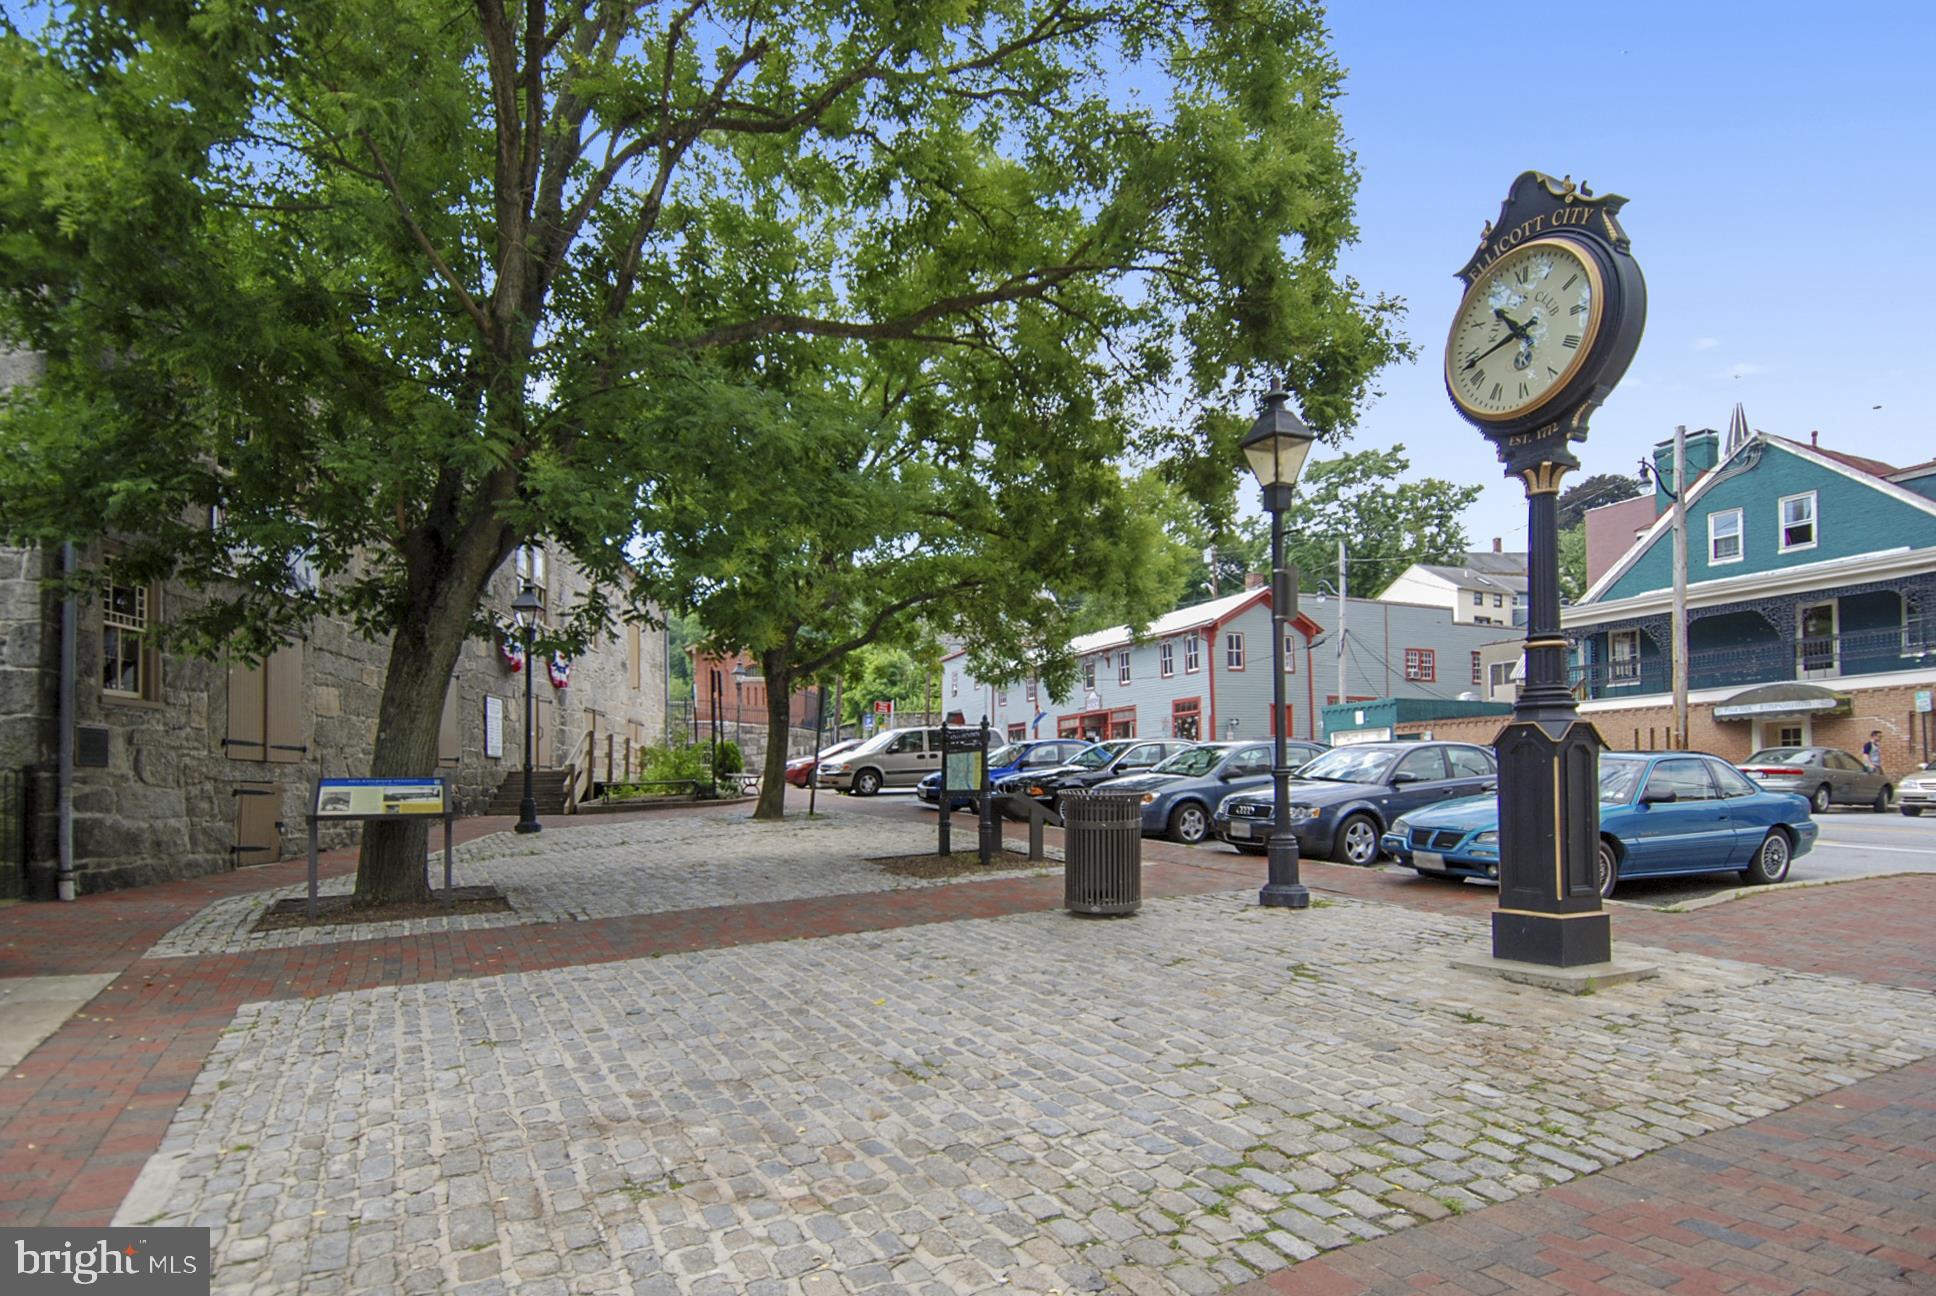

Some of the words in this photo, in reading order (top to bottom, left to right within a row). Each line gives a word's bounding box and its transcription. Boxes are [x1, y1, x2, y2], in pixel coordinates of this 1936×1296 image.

[1469, 214, 1545, 280] ELLICOTT
[1551, 206, 1595, 227] CITY
[1509, 433, 1532, 447] EST.
